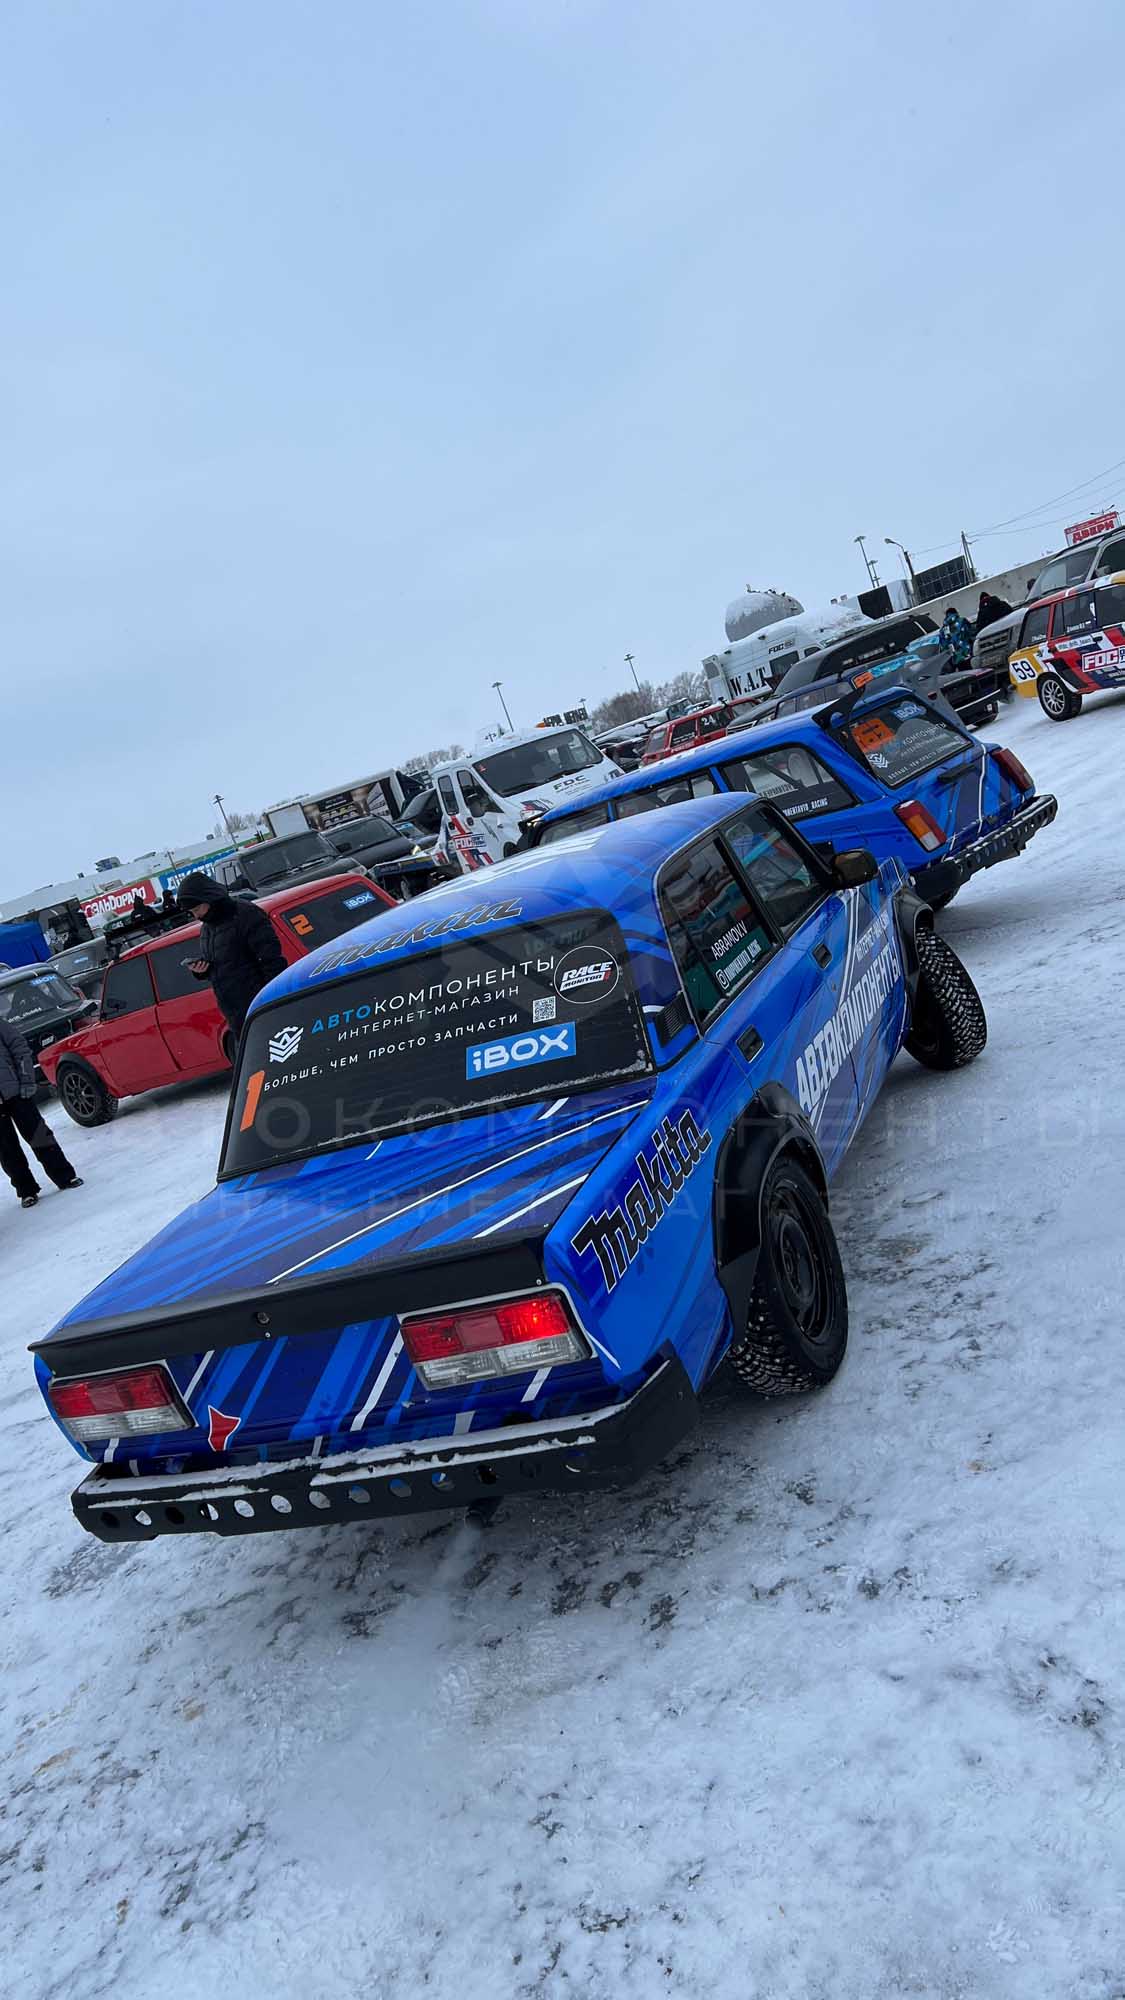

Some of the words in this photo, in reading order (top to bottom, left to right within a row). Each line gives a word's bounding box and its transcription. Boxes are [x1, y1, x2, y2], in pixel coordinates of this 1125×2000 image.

[1011, 660, 1036, 680] 59
[701, 714, 716, 726] 24
[345, 892, 373, 908] iBOX
[290, 913, 314, 935] 2
[711, 919, 748, 960] ABRAMOV.V
[562, 961, 614, 981] RACE
[311, 955, 554, 1034] АВТОКОМПОНЕНТЫ
[337, 985, 520, 1042] ИНТЕРНЕТ-МАГАЗИН
[795, 936, 901, 1113] АВТОКОМПОНЕНТЫ
[264, 1065, 324, 1092] БОЛЬШЕ,
[330, 1053, 359, 1069] ЧЕМ
[368, 1036, 427, 1060] ПРОСТО
[434, 1013, 519, 1042] ЗАПЧАСТИ
[472, 1028, 569, 1072] iBOX
[240, 1070, 265, 1132] 1
